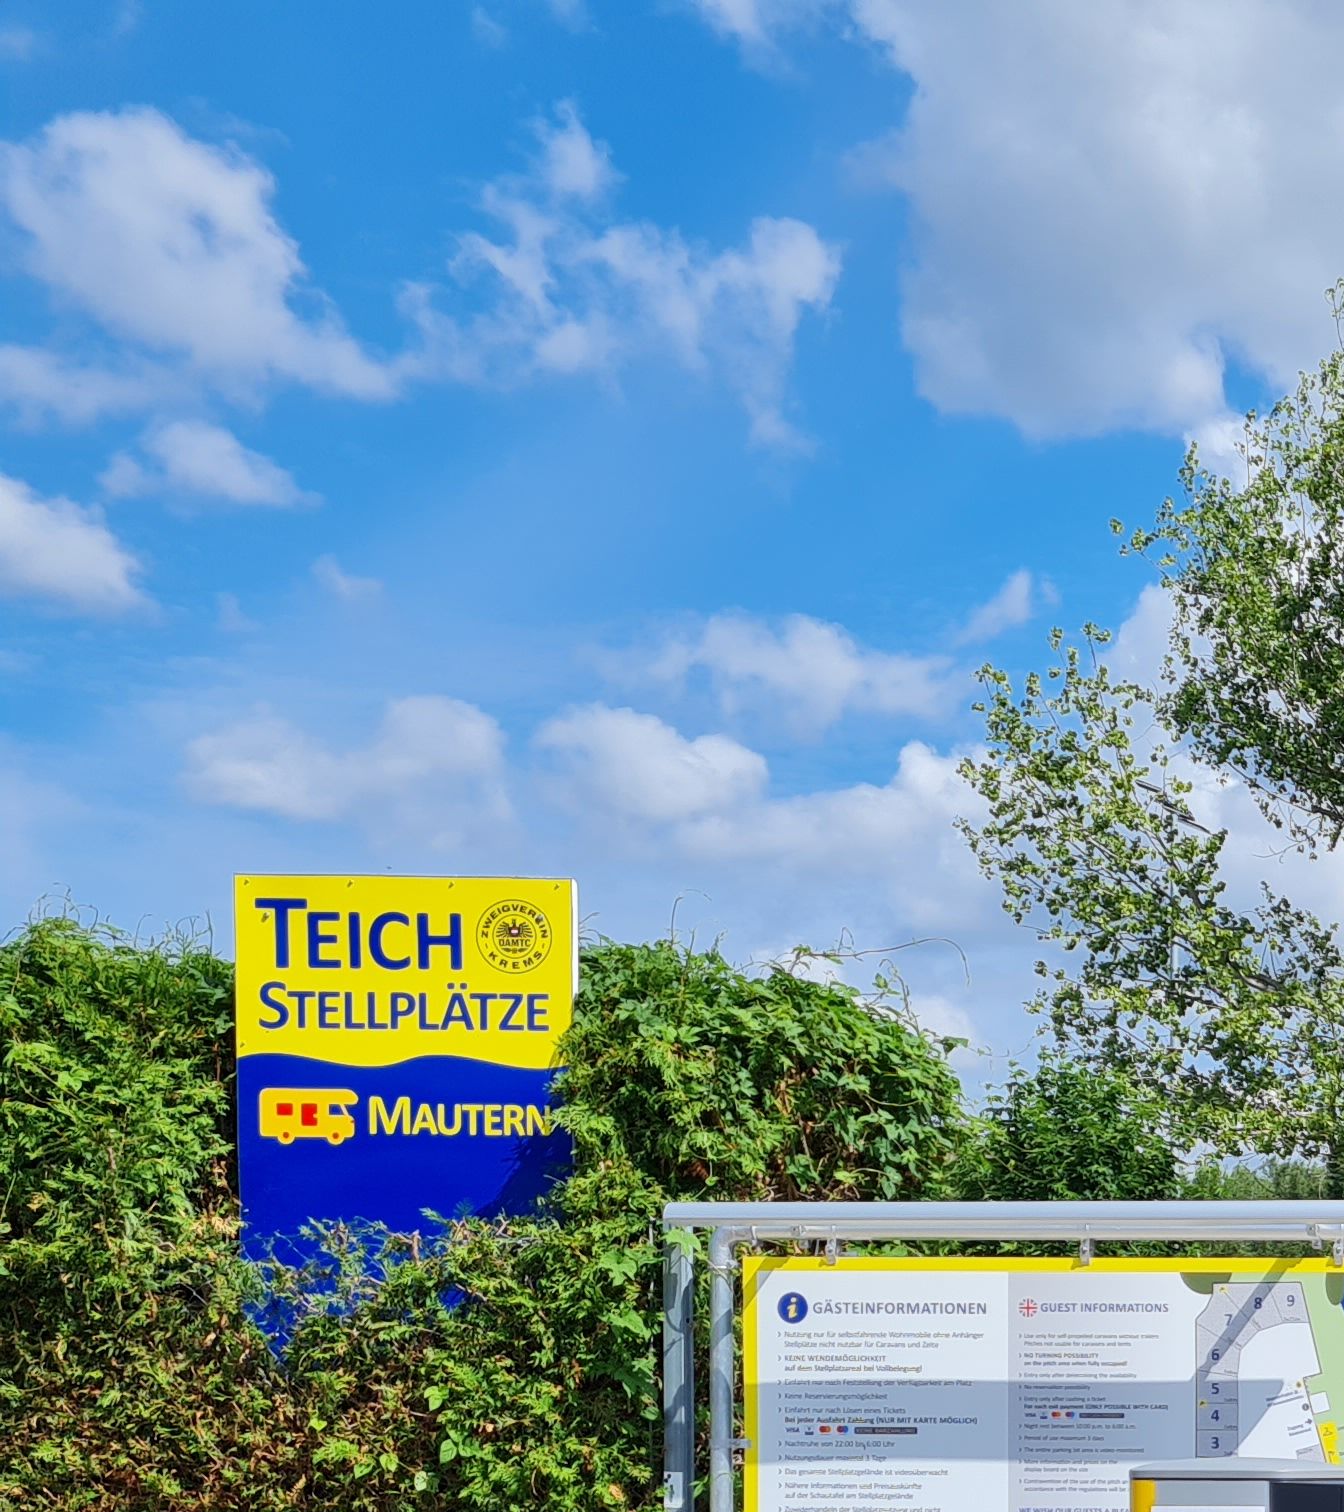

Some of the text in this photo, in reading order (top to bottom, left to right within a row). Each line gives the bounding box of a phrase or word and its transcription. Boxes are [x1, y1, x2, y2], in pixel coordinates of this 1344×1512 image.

[481, 904, 549, 939] ZWEIGVERIN
[255, 898, 463, 971] TEICH
[488, 951, 543, 969] KREMS
[259, 981, 550, 1032] STELLPLÄTZE
[369, 1096, 551, 1136] MAUTERN
[1254, 1297, 1262, 1309] 8
[1286, 1295, 1295, 1306] 9
[812, 1300, 987, 1315] GÄSTEINFORMATIONEN
[1040, 1302, 1169, 1313] GUEST INFORMATIONS
[1224, 1314, 1233, 1326] 7
[1211, 1349, 1220, 1361] 6
[1211, 1383, 1220, 1394] 5
[1210, 1410, 1220, 1421] 4
[1211, 1437, 1220, 1449] 3
